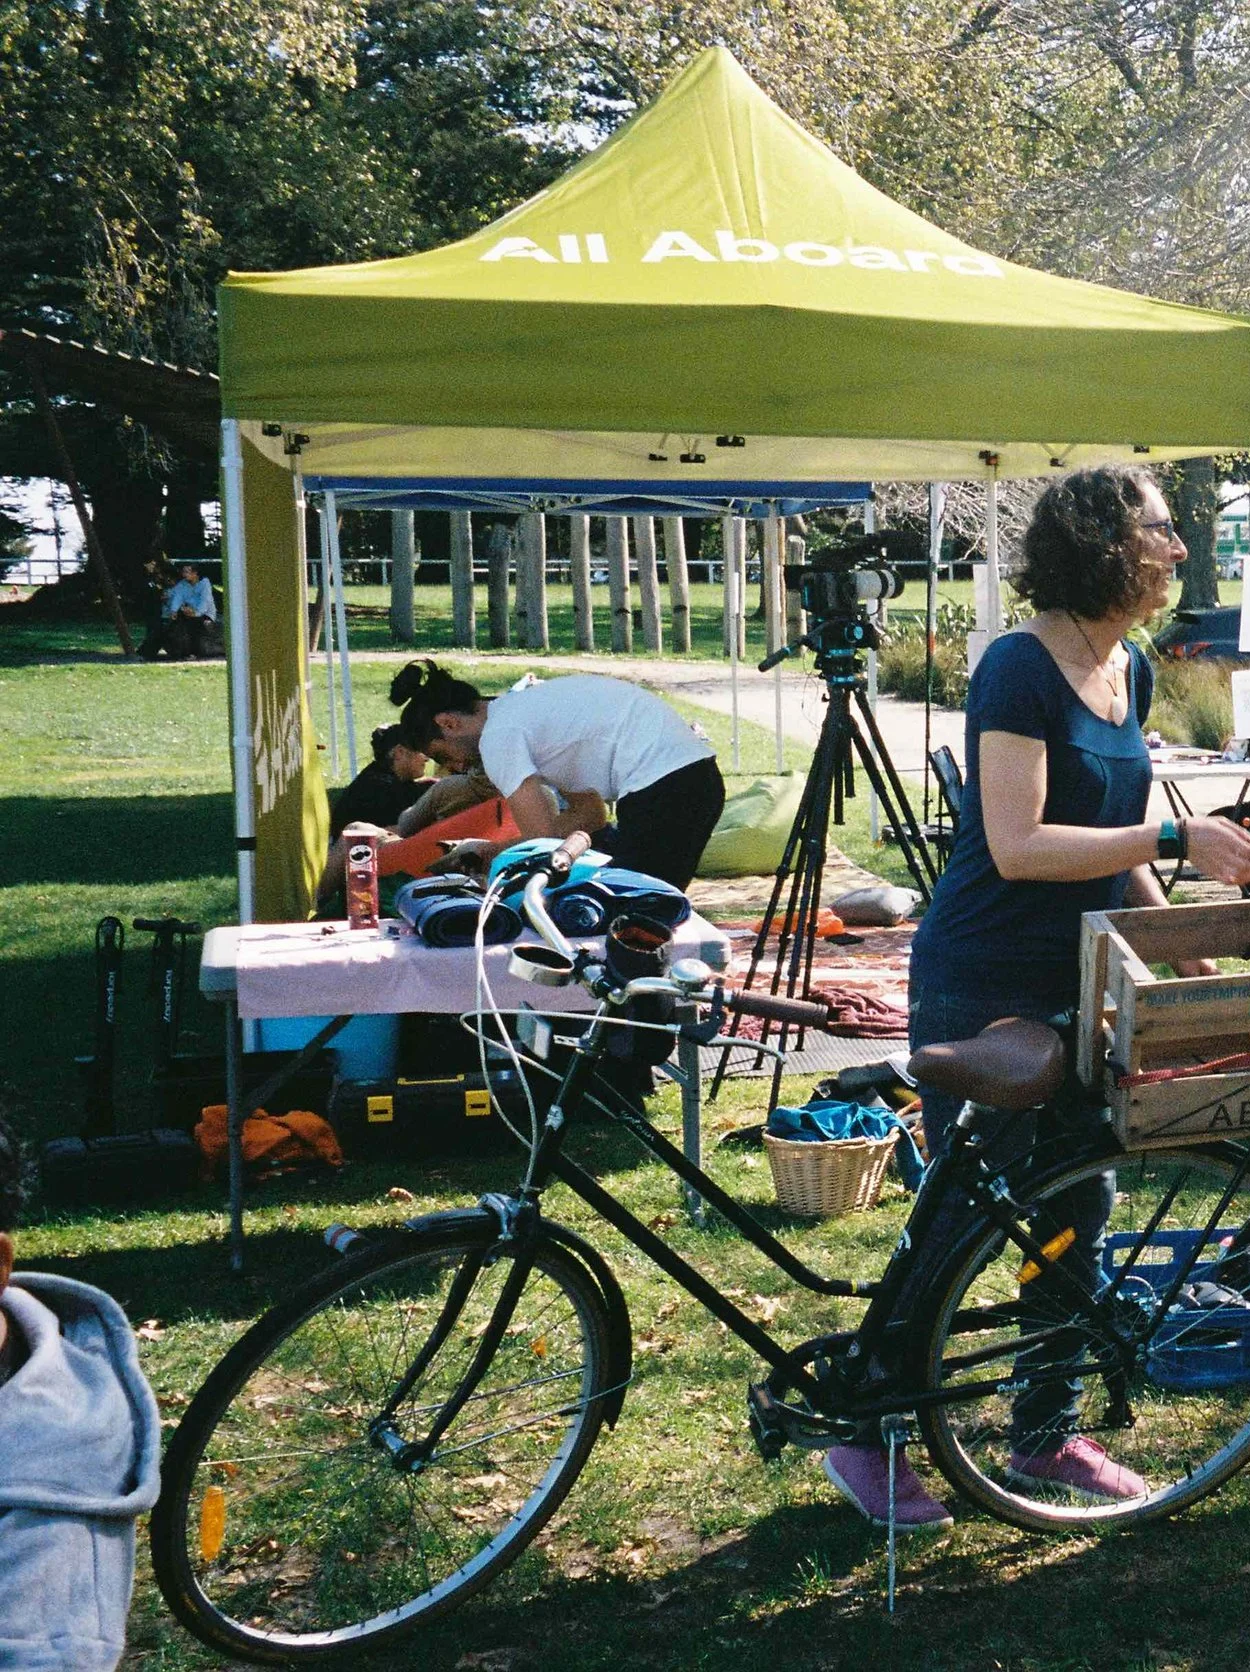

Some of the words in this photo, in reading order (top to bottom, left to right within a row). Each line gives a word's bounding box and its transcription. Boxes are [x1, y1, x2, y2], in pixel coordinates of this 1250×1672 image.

[478, 233, 609, 264] All
[640, 230, 1005, 277] Aboard
[106, 971, 116, 1023] torpedo7
[163, 969, 173, 1022] torpedo7
[996, 1378, 1030, 1393] Pedal
